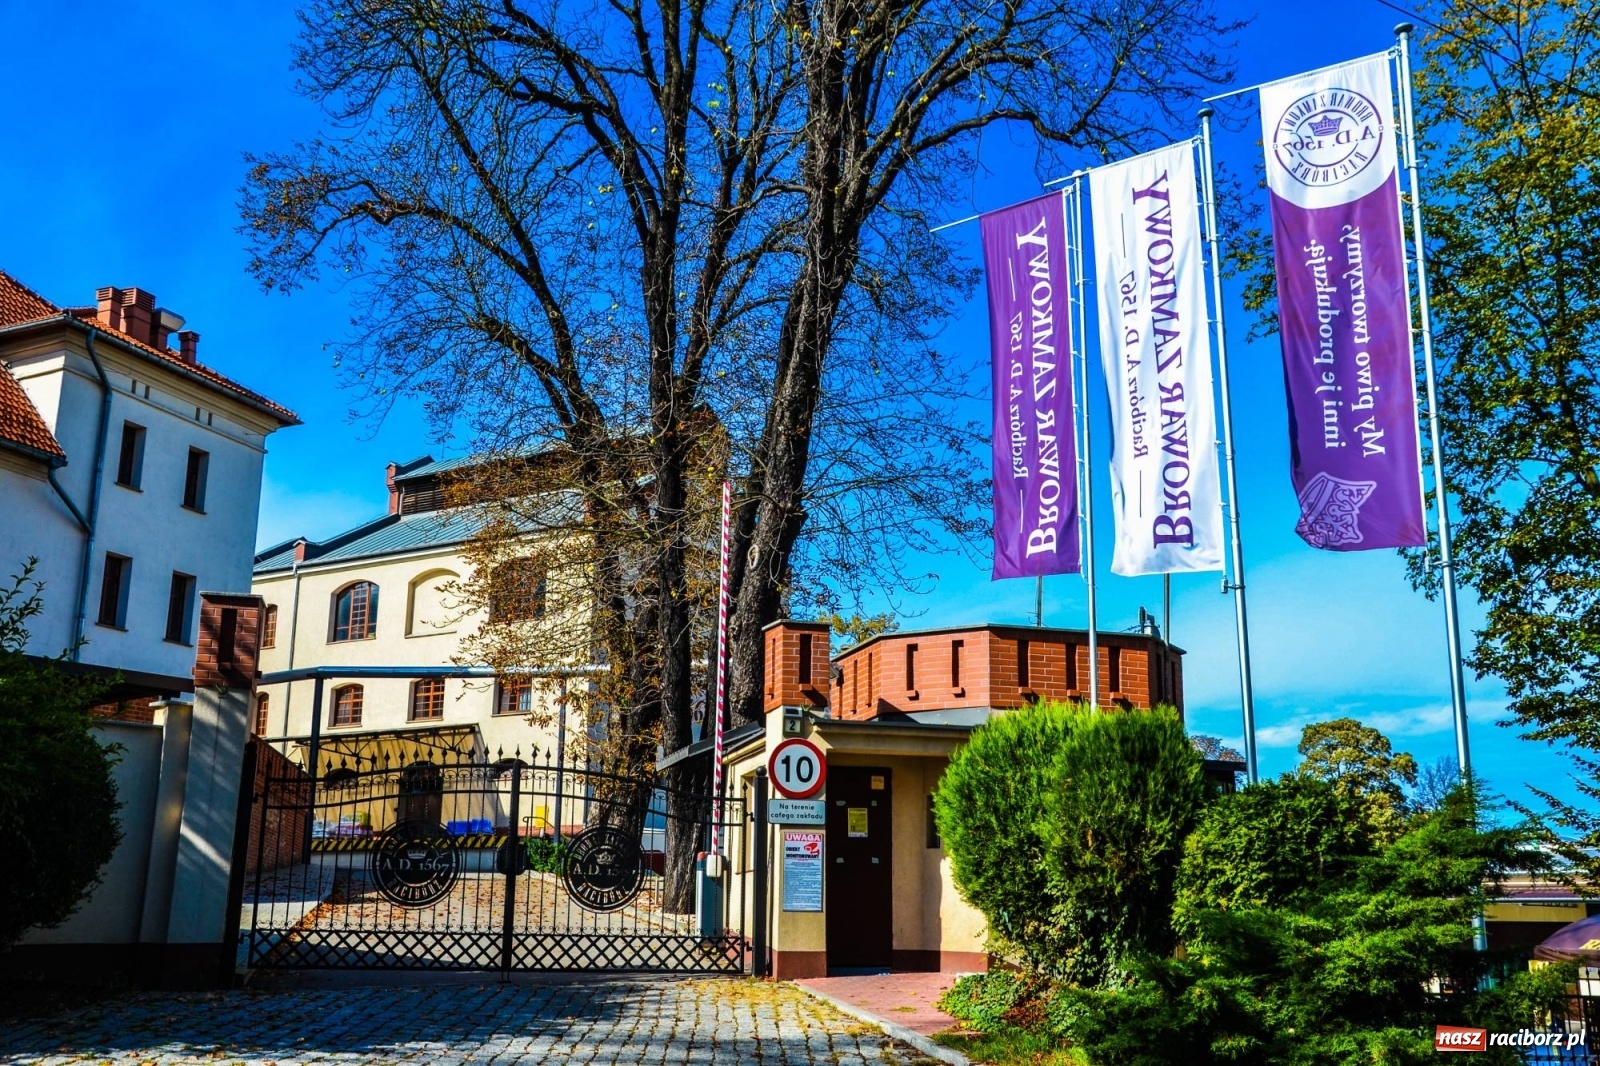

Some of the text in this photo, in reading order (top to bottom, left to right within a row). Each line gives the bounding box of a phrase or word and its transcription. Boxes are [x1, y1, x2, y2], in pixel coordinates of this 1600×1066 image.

[789, 720, 796, 731] 2
[781, 754, 814, 783] 10
[791, 803, 815, 811] terenie
[770, 812, 823, 820] całego zakładu
[786, 833, 821, 842] UWAGA
[419, 857, 450, 877] 1567
